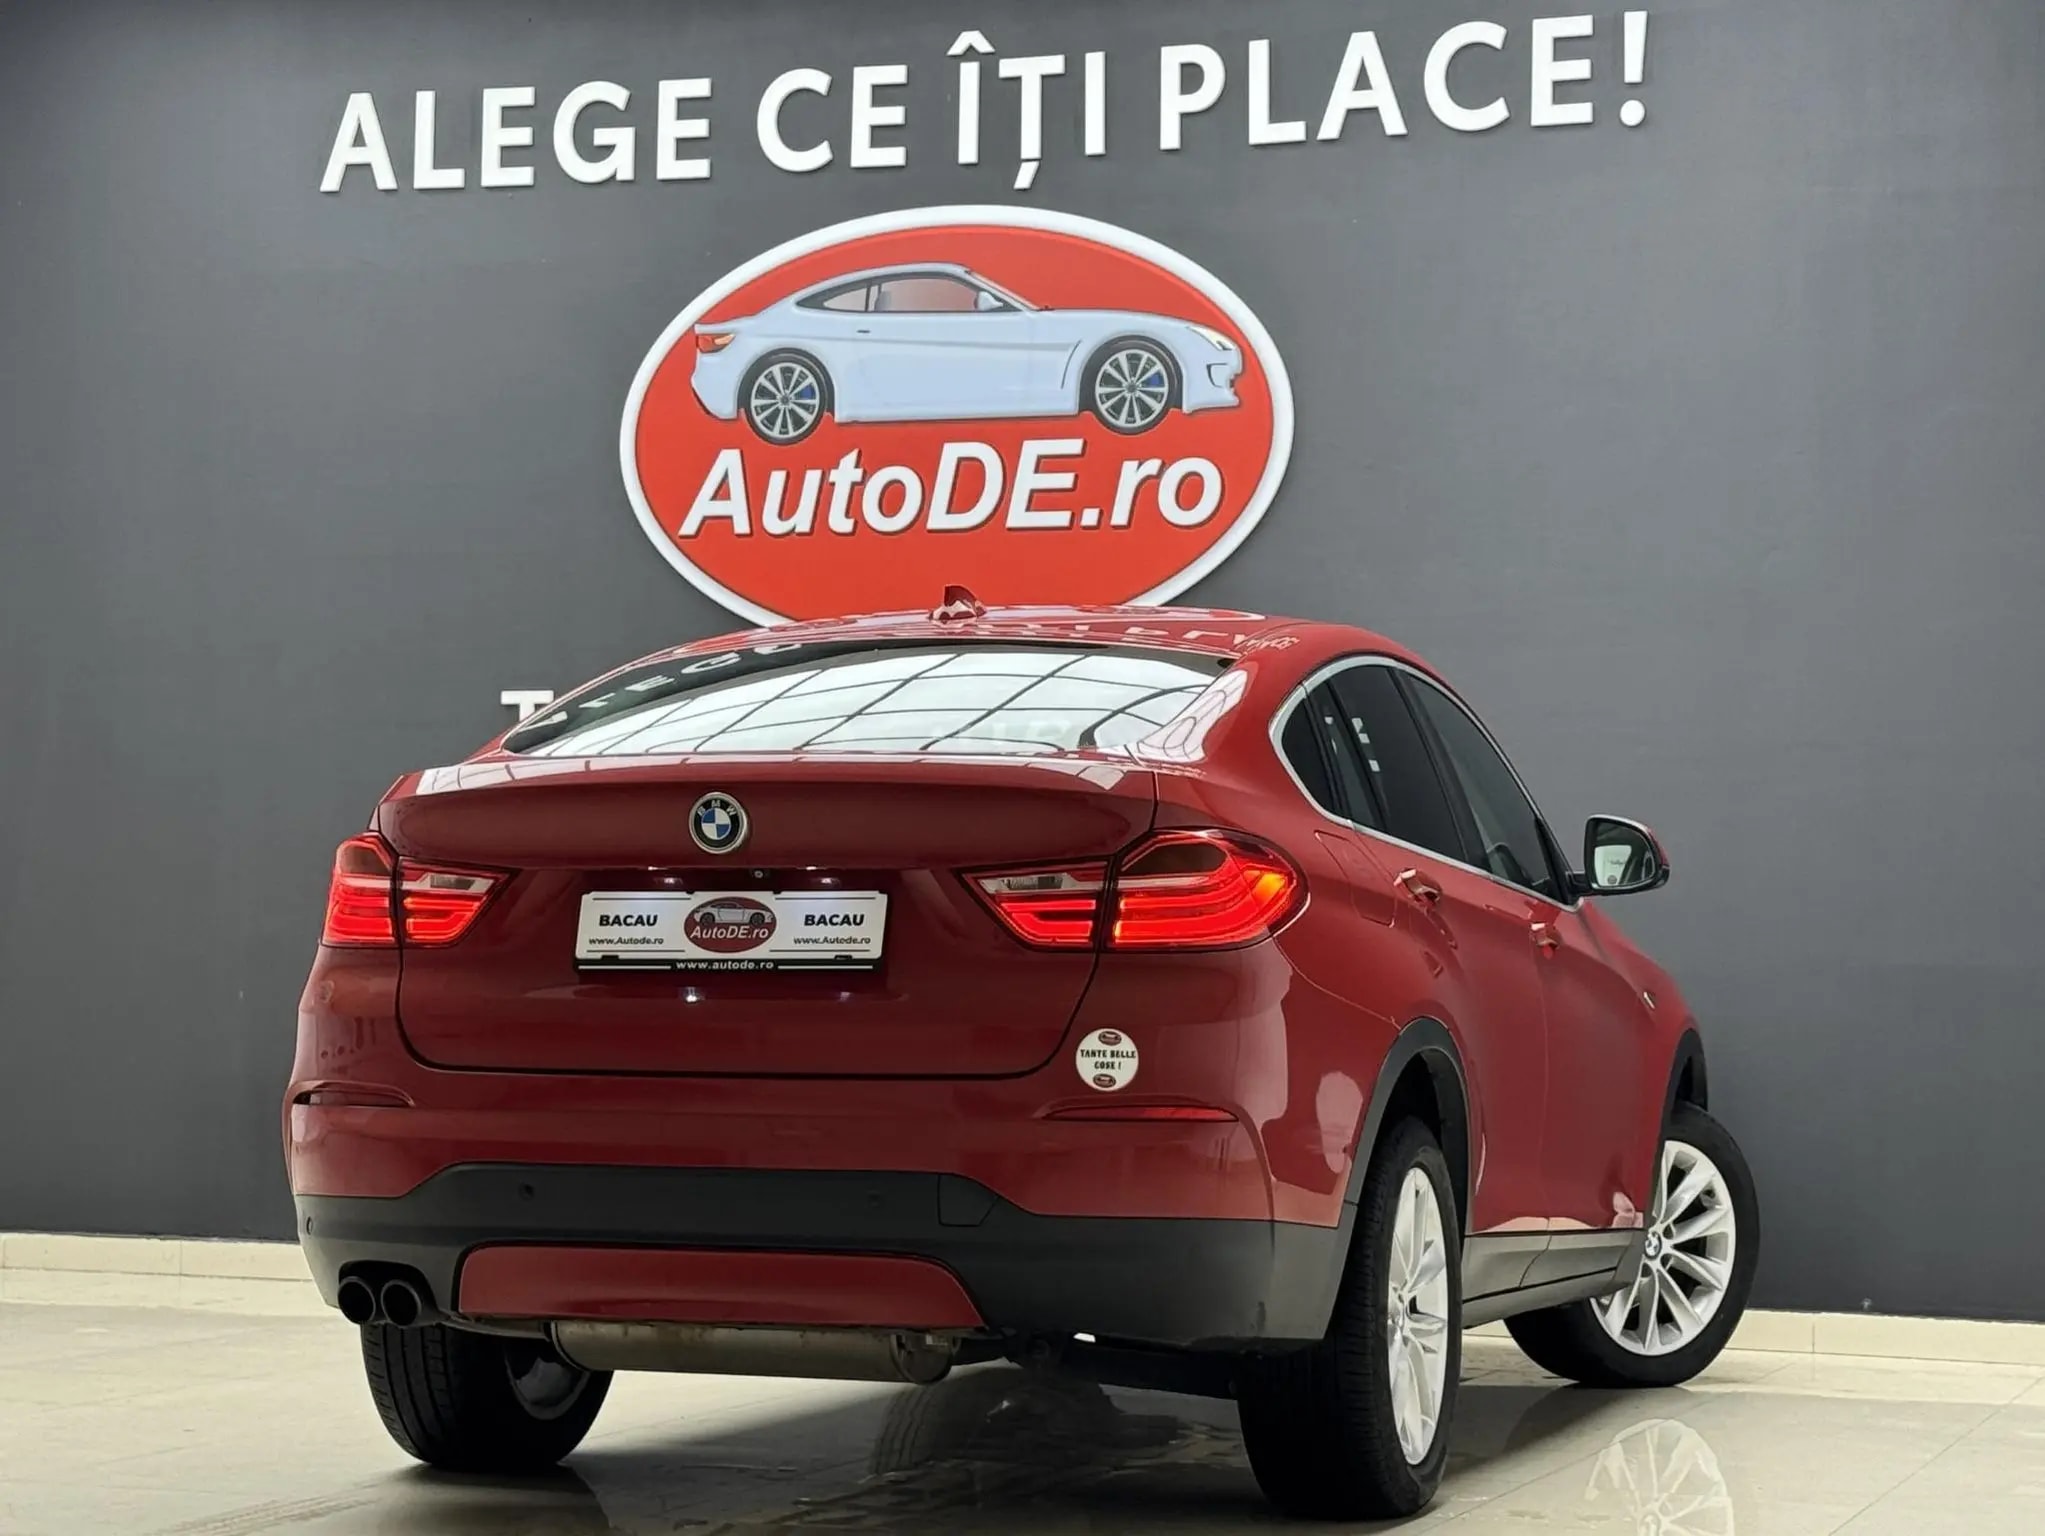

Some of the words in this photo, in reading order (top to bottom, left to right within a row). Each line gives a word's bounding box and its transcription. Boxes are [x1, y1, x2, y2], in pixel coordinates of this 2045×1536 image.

[319, 77, 712, 193] ALEGE
[757, 64, 908, 172] CE
[1159, 10, 1649, 151] PLACE!
[678, 437, 1223, 538] AutoDE.ro
[697, 799, 737, 817] BMW
[599, 914, 658, 927] BACAU
[804, 914, 865, 926] BACAU
[690, 925, 769, 939] AutoDE.ro
[589, 936, 664, 945] www.Autode.ro
[1080, 1049, 1107, 1058] TANTE
[1110, 1050, 1136, 1059] BELLE
[1094, 1061, 1115, 1070] COSE
